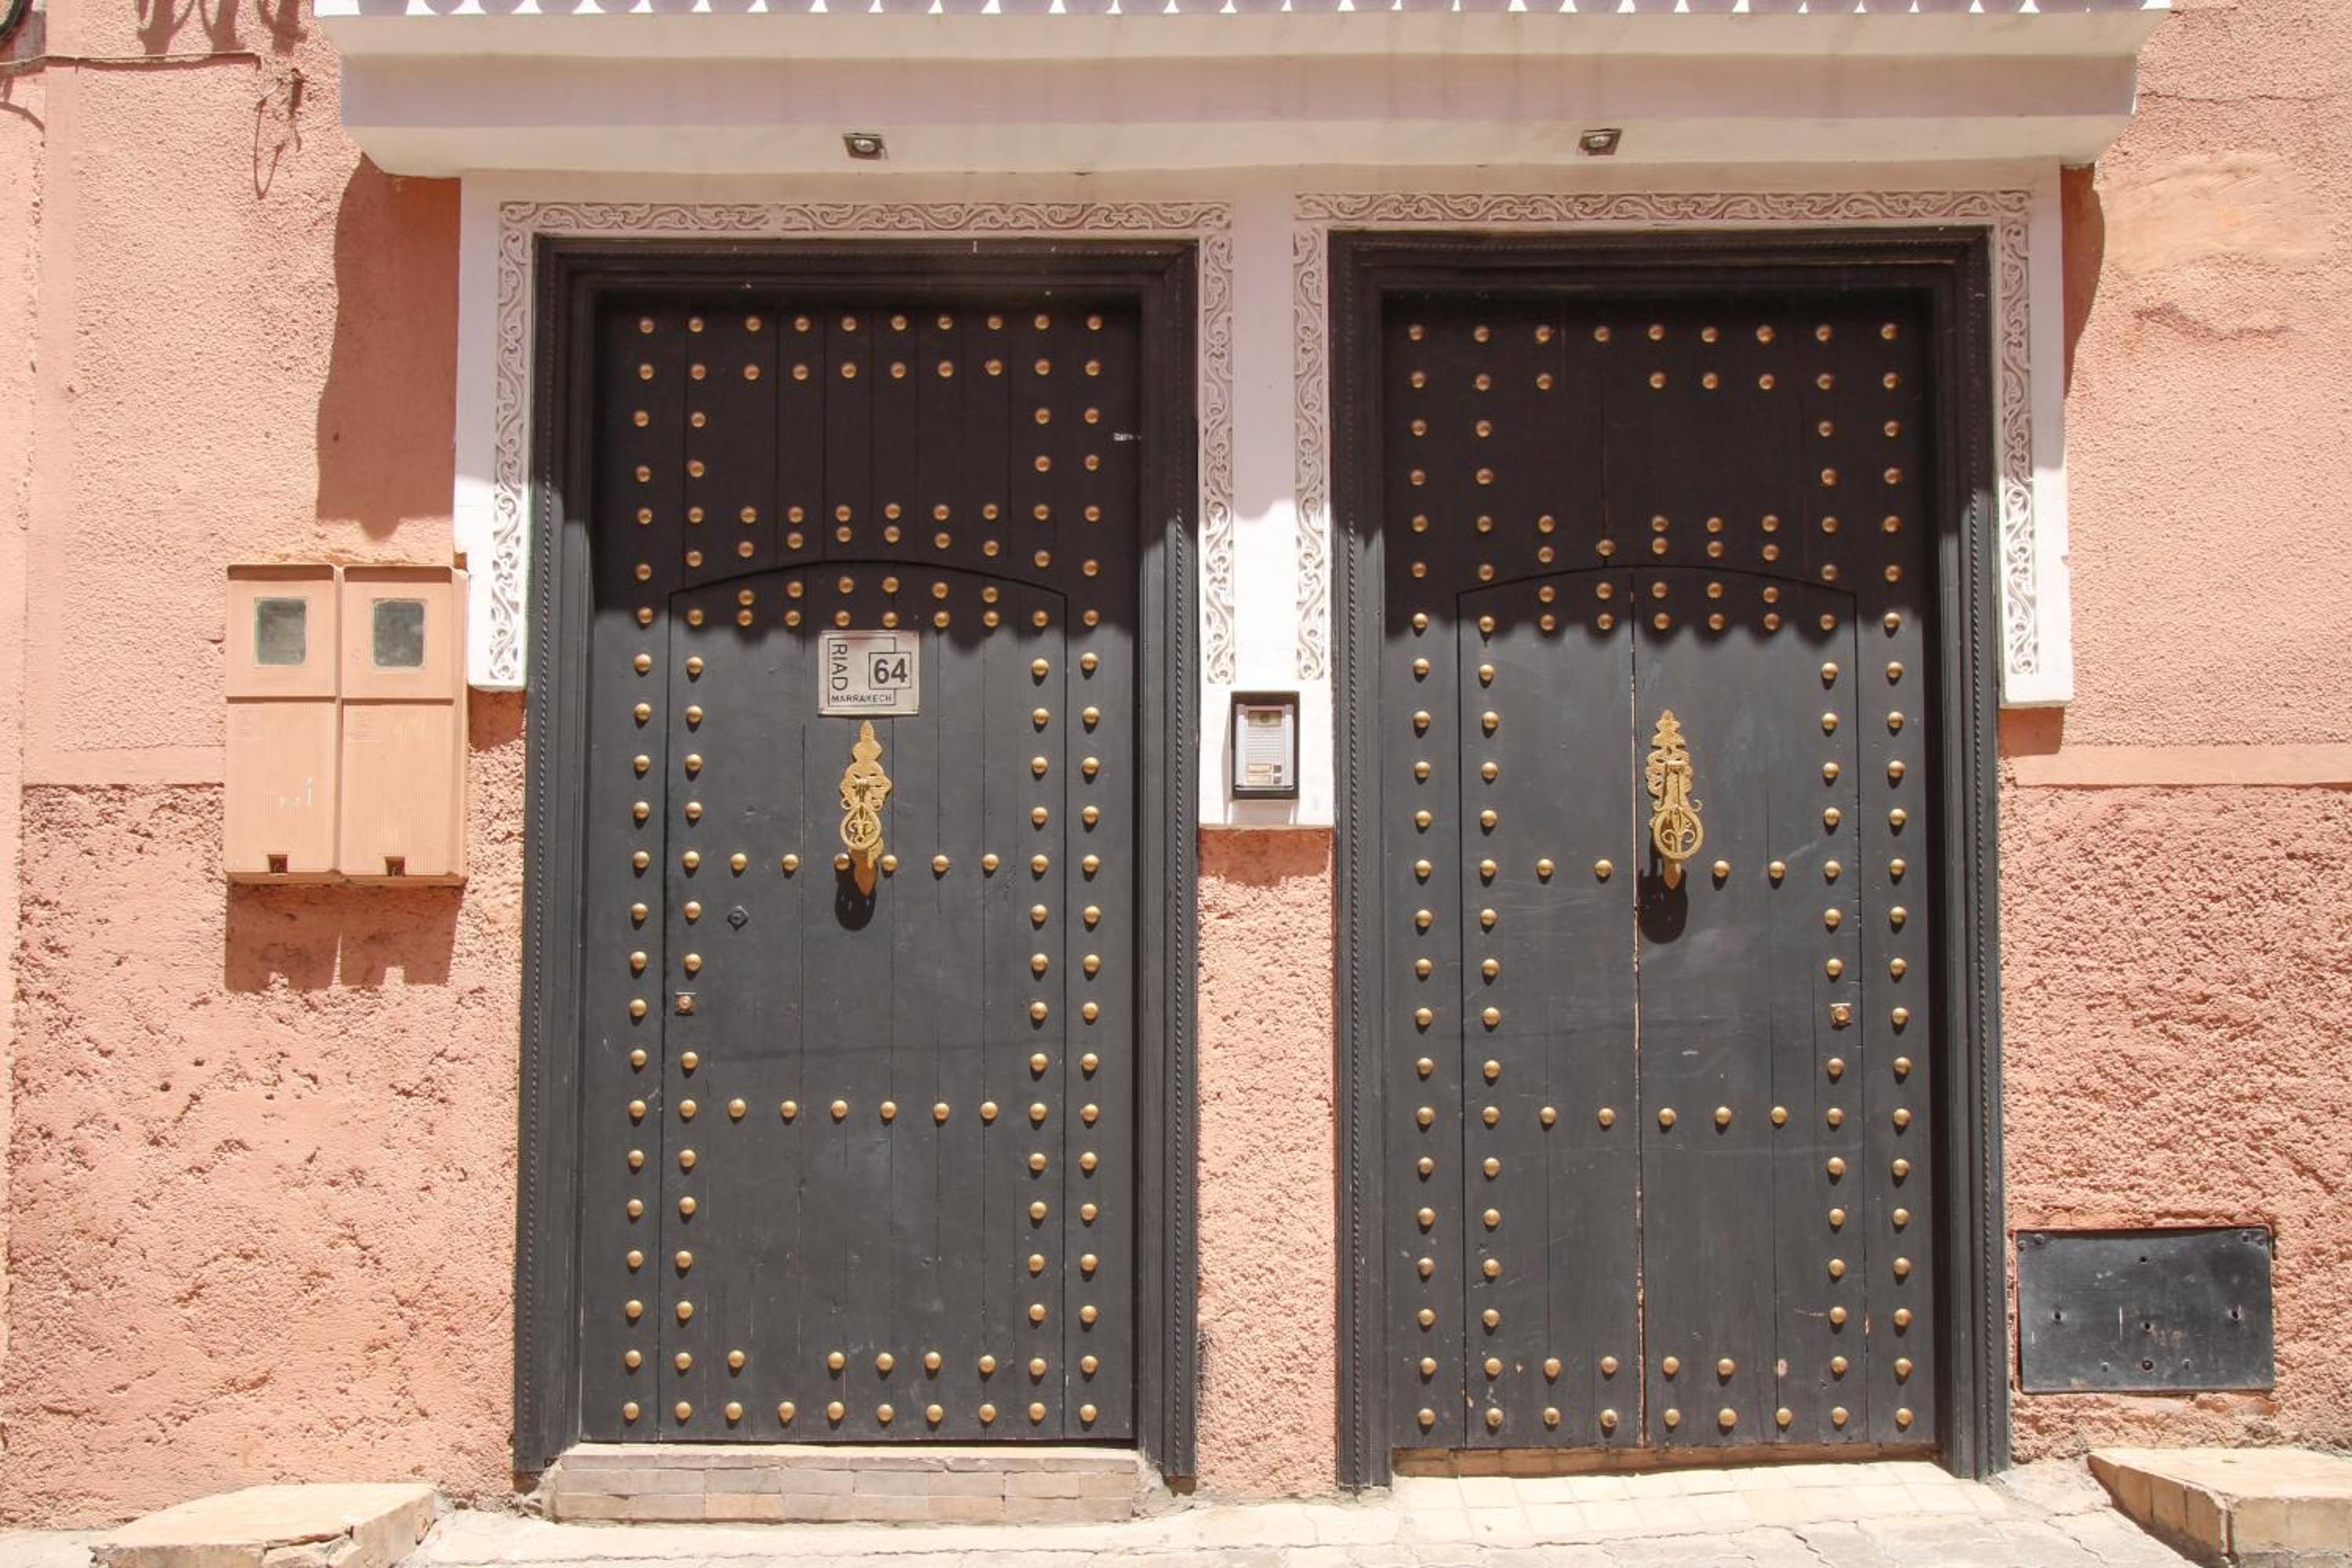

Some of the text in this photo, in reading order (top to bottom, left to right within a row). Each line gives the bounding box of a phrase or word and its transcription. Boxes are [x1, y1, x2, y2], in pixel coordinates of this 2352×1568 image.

[832, 644, 848, 691] RIAD
[874, 658, 907, 684] 64
[832, 694, 891, 703] MARRAKECH
